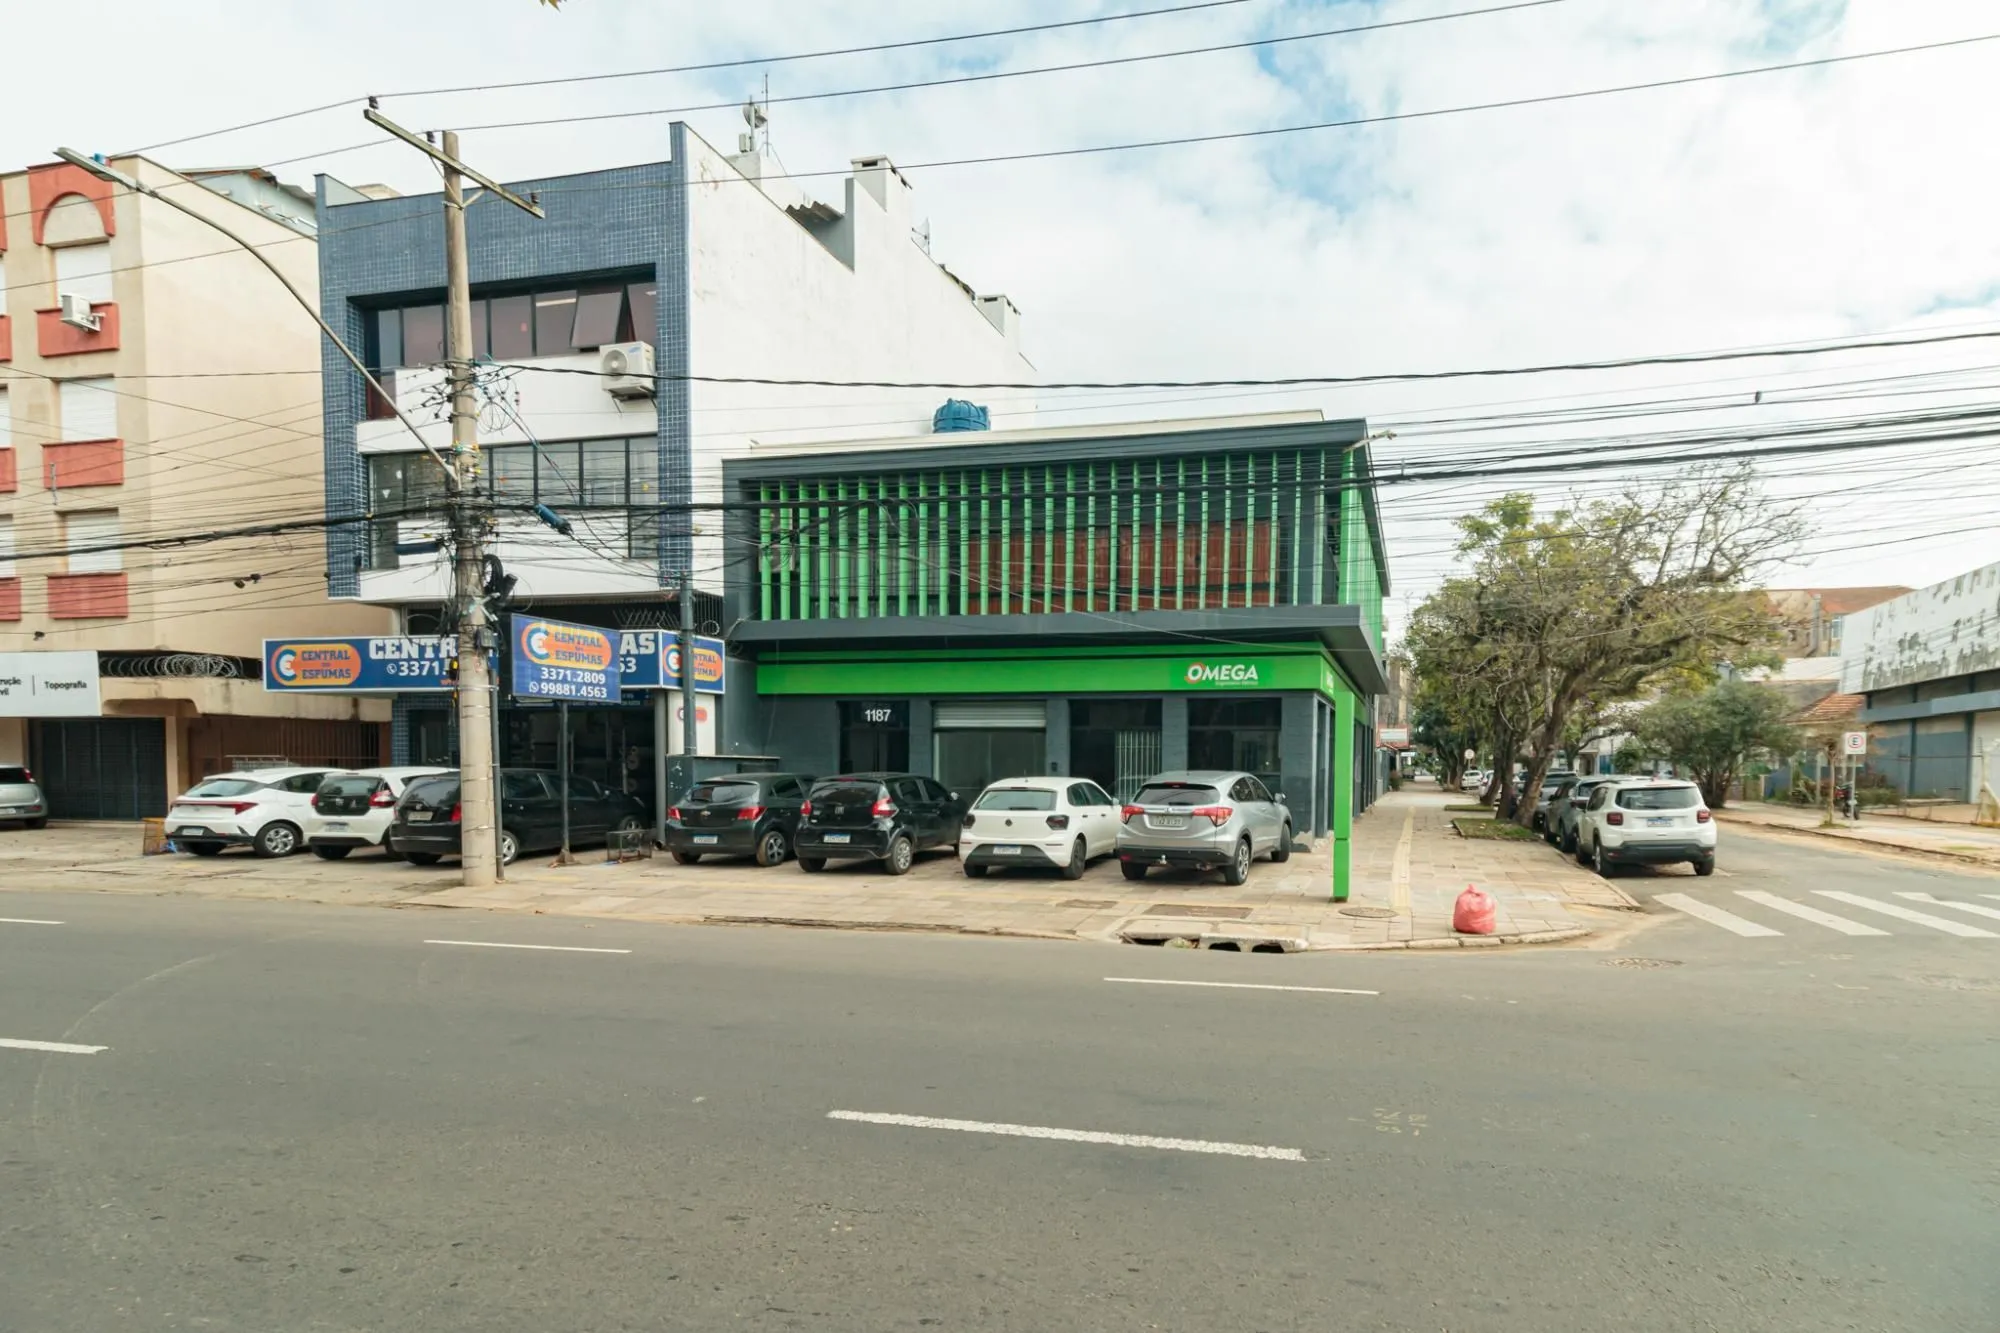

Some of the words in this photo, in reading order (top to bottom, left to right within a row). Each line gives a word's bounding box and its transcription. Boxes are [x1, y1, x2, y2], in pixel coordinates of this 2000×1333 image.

[554, 631, 603, 648] CENTRAL
[302, 650, 351, 661] CENTRAL
[369, 638, 458, 660] CENTR
[555, 649, 603, 665] ESPUMAS
[302, 668, 352, 680] ESPUMAS
[541, 667, 606, 685] 3371.2809
[1187, 664, 1258, 681] OMEGA
[45, 681, 87, 691] Topografia
[541, 682, 607, 699] 99881.4563
[865, 709, 891, 722] 1187
[1852, 736, 1859, 746] E
